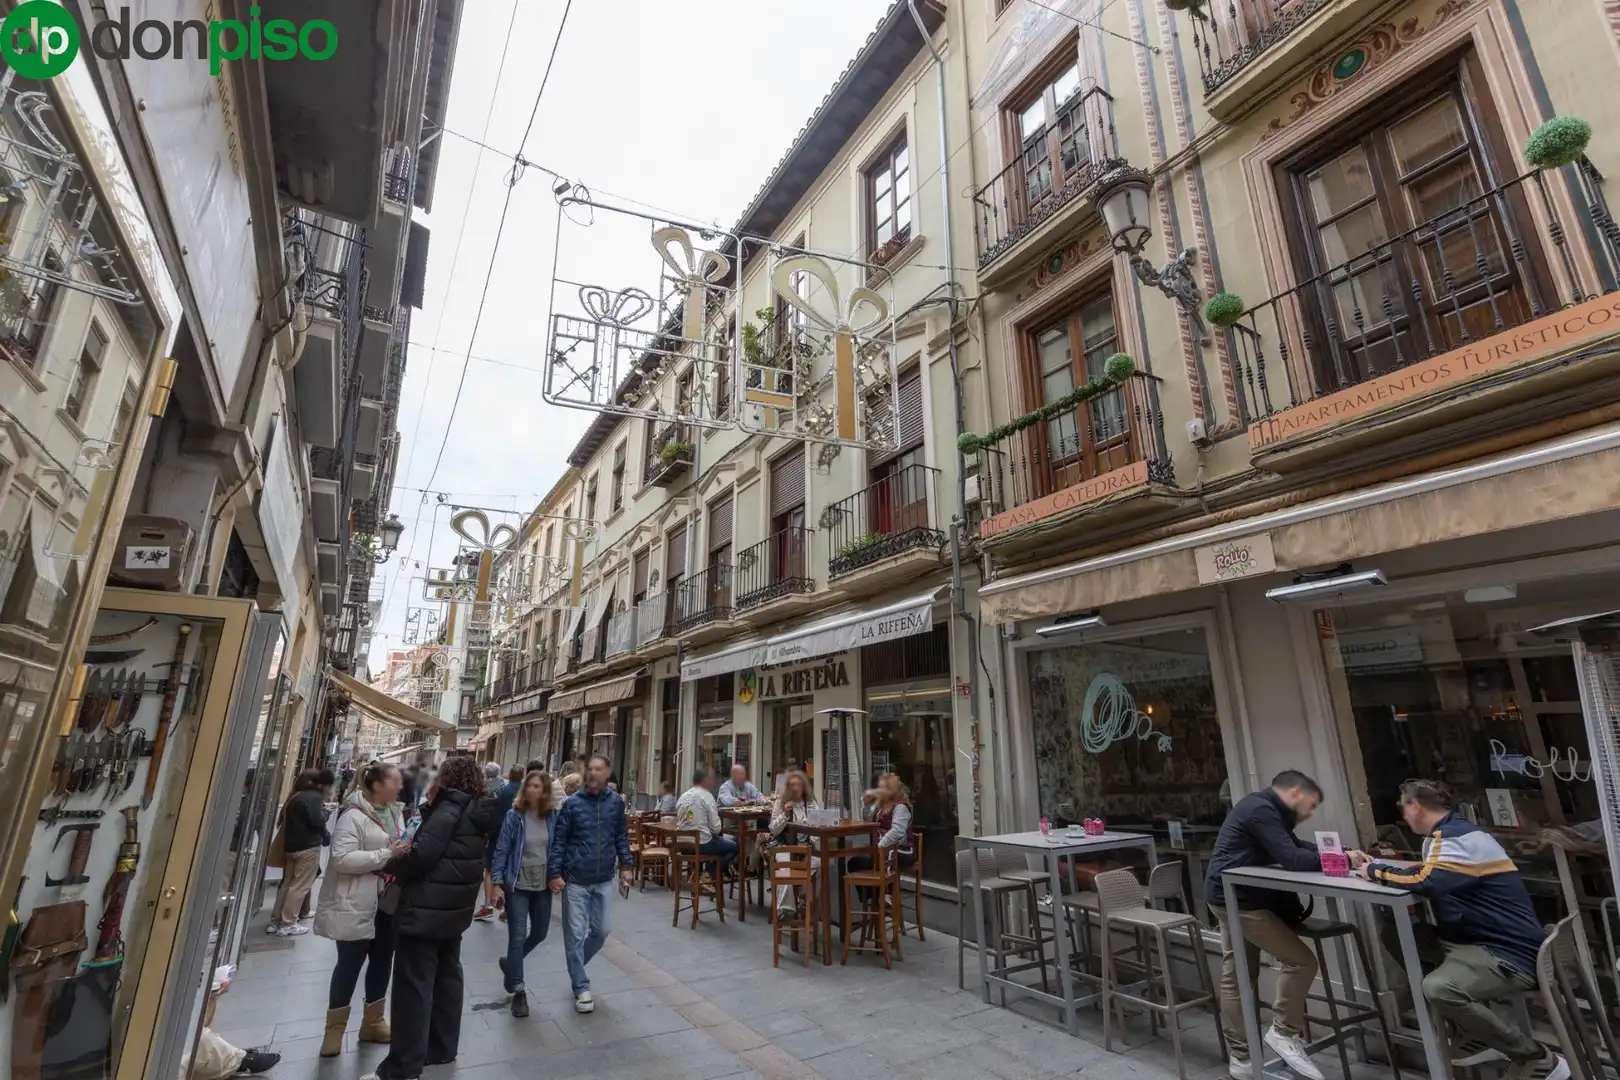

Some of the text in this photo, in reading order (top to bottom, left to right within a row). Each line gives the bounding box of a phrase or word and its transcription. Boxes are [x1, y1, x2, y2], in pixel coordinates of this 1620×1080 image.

[1282, 363, 1452, 433] APARTAMENTOS
[998, 467, 1143, 530] CASA CATEDRAL
[1216, 549, 1249, 569] ROLLO
[861, 613, 924, 638] LA RIFFEÑA
[758, 676, 777, 697] LA
[781, 658, 850, 695] RIFFEÑA
[1489, 739, 1593, 782] Roll
